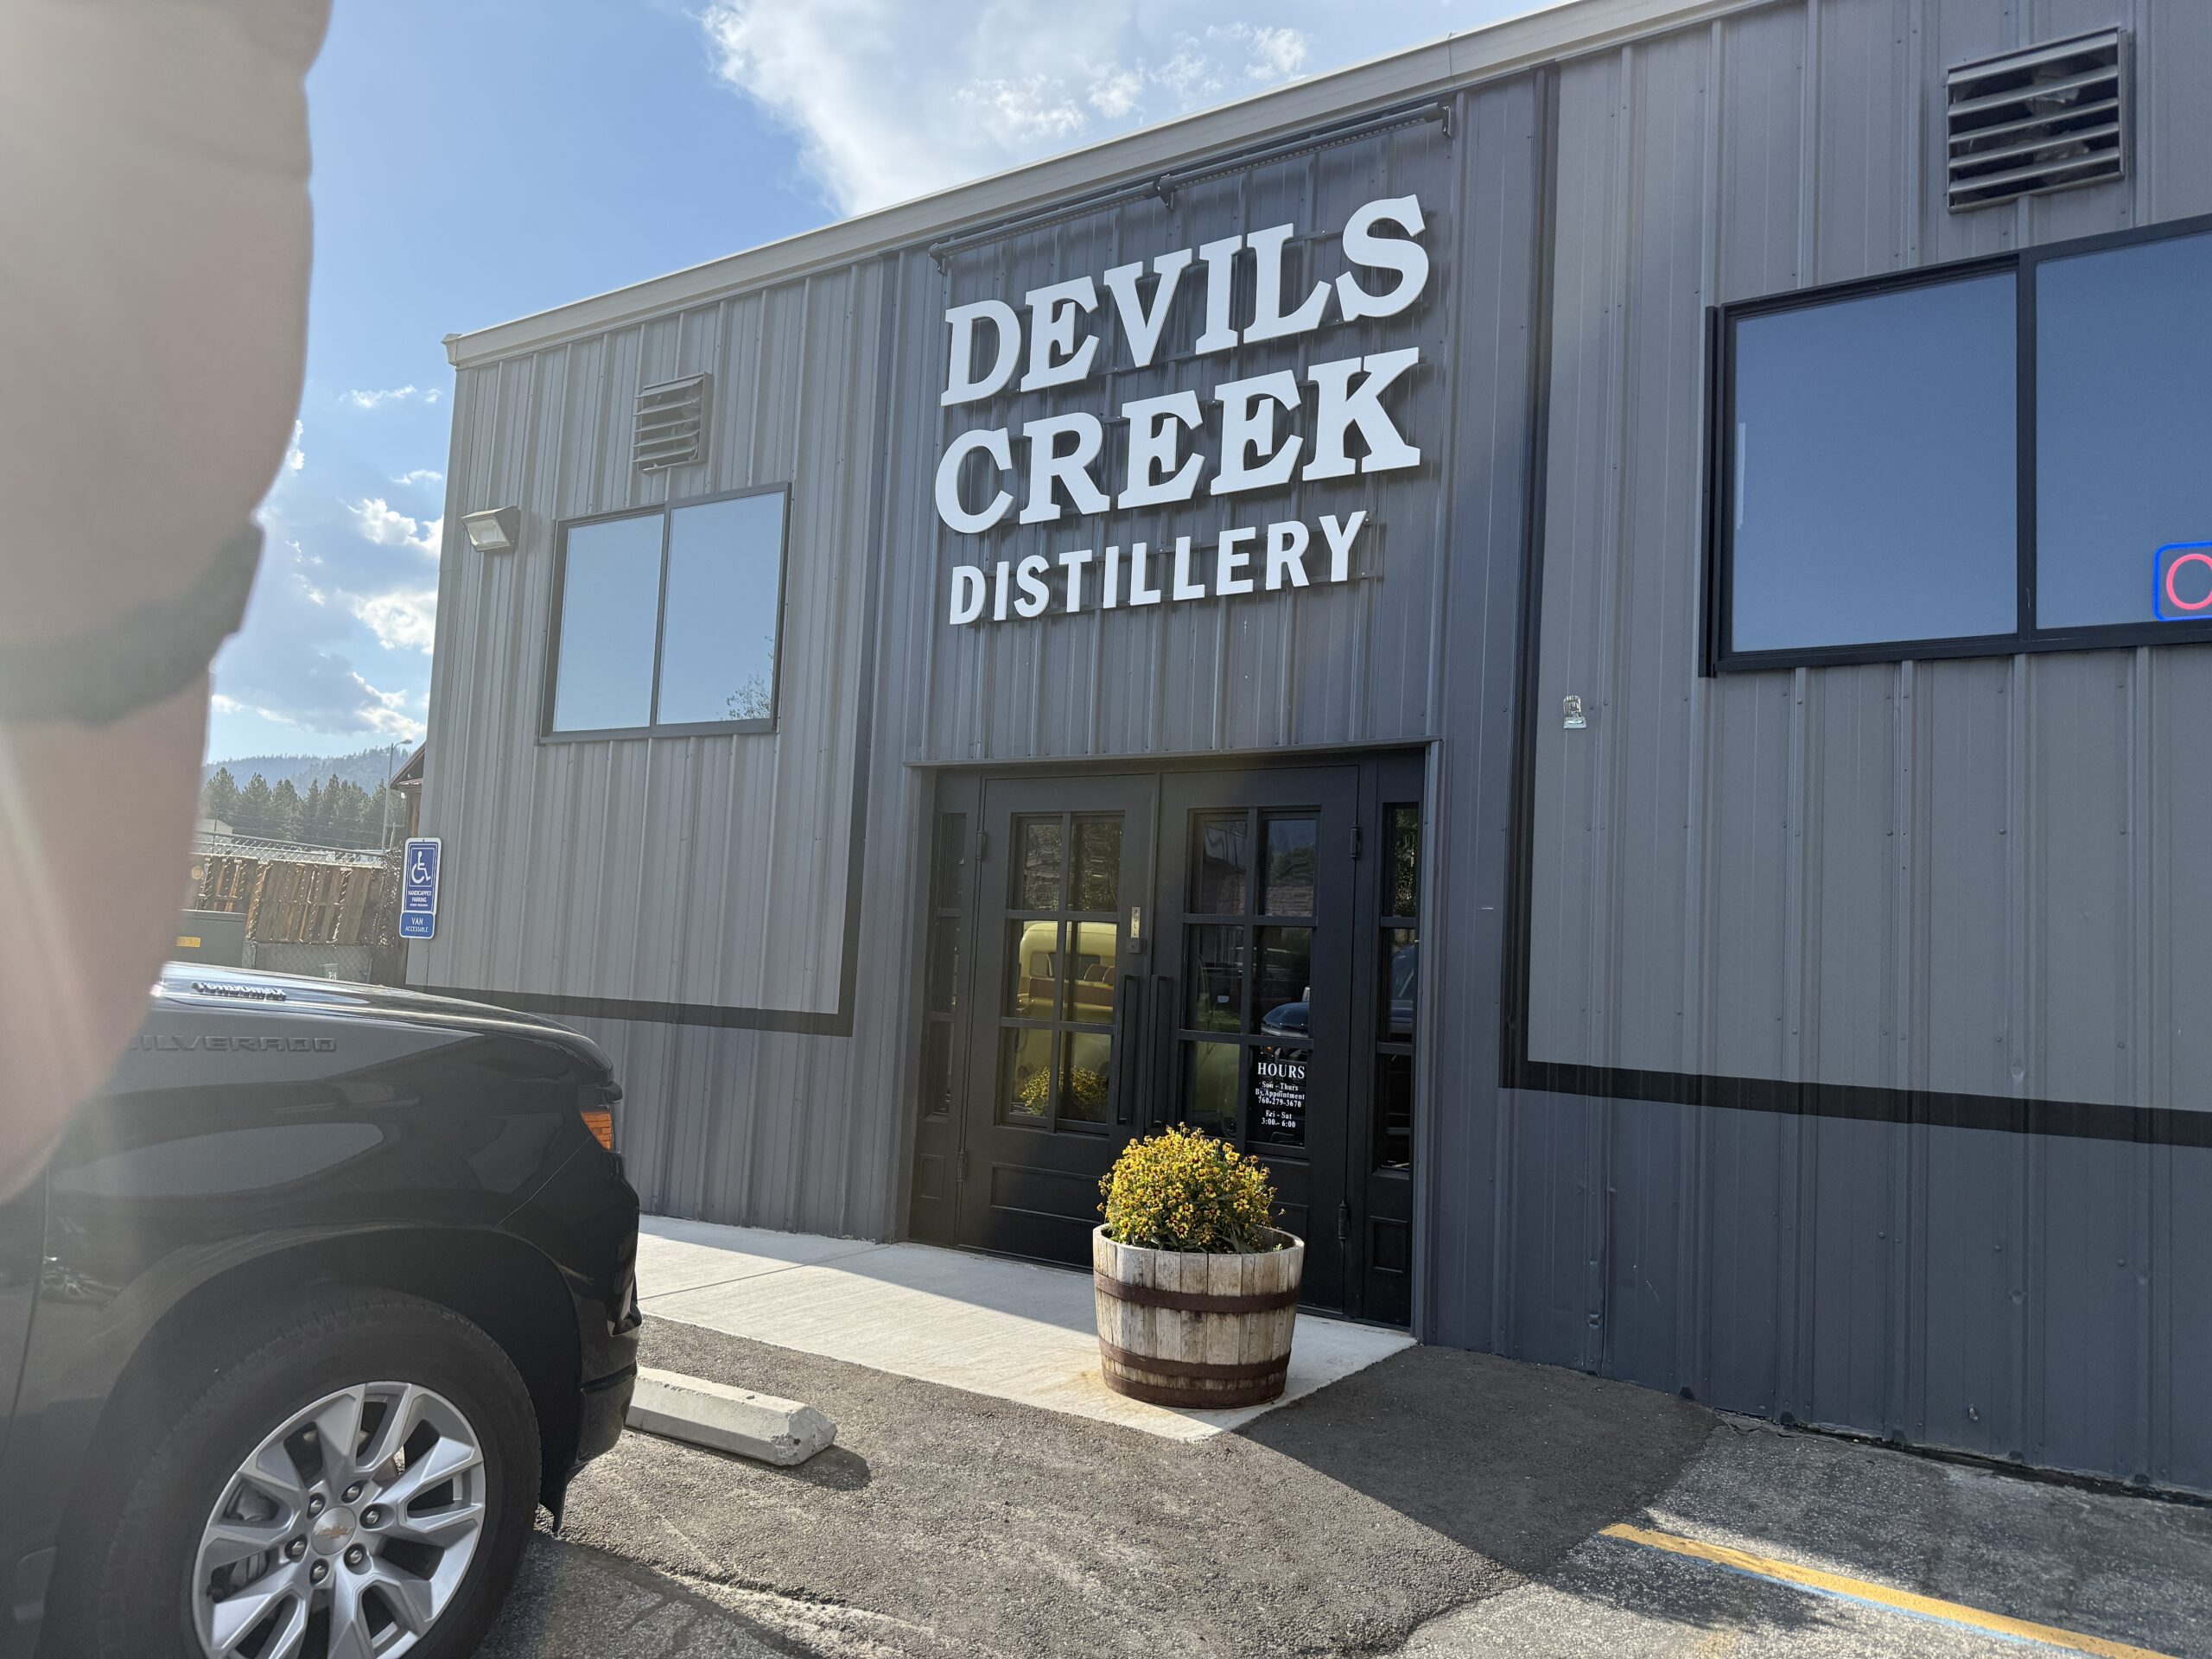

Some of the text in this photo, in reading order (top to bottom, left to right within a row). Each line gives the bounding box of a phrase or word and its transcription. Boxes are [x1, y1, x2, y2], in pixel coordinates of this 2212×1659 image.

[941, 194, 1430, 407] DEVILS
[934, 347, 1421, 534] CREEK
[949, 511, 1368, 626] DISTILLERY
[412, 917, 423, 925] VAN
[1257, 1062, 1305, 1079] HOURS
[1265, 1089, 1305, 1100] Appointment
[1281, 1083, 1298, 1091] Thurs
